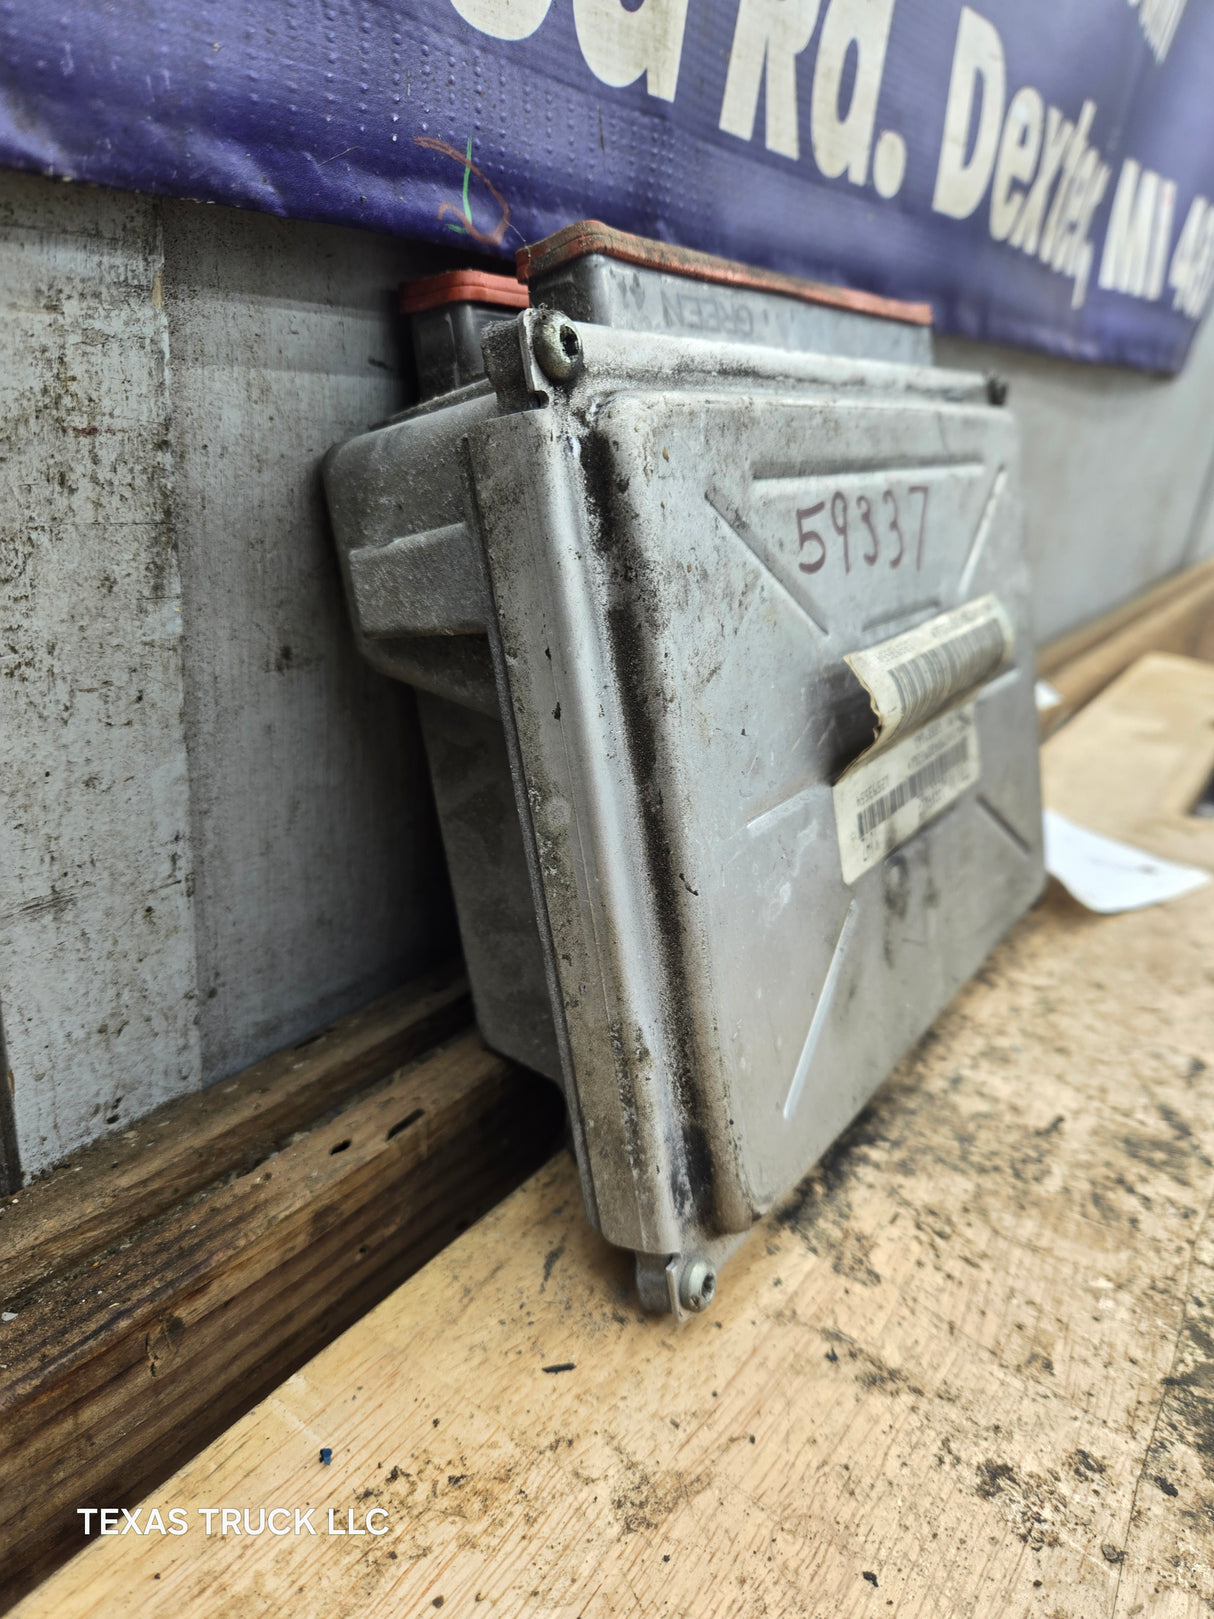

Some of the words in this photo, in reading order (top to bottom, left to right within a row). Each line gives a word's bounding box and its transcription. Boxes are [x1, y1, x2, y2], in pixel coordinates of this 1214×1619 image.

[1098, 157, 1178, 302] MI
[660, 289, 754, 338] GREEN
[796, 485, 929, 575] 59337
